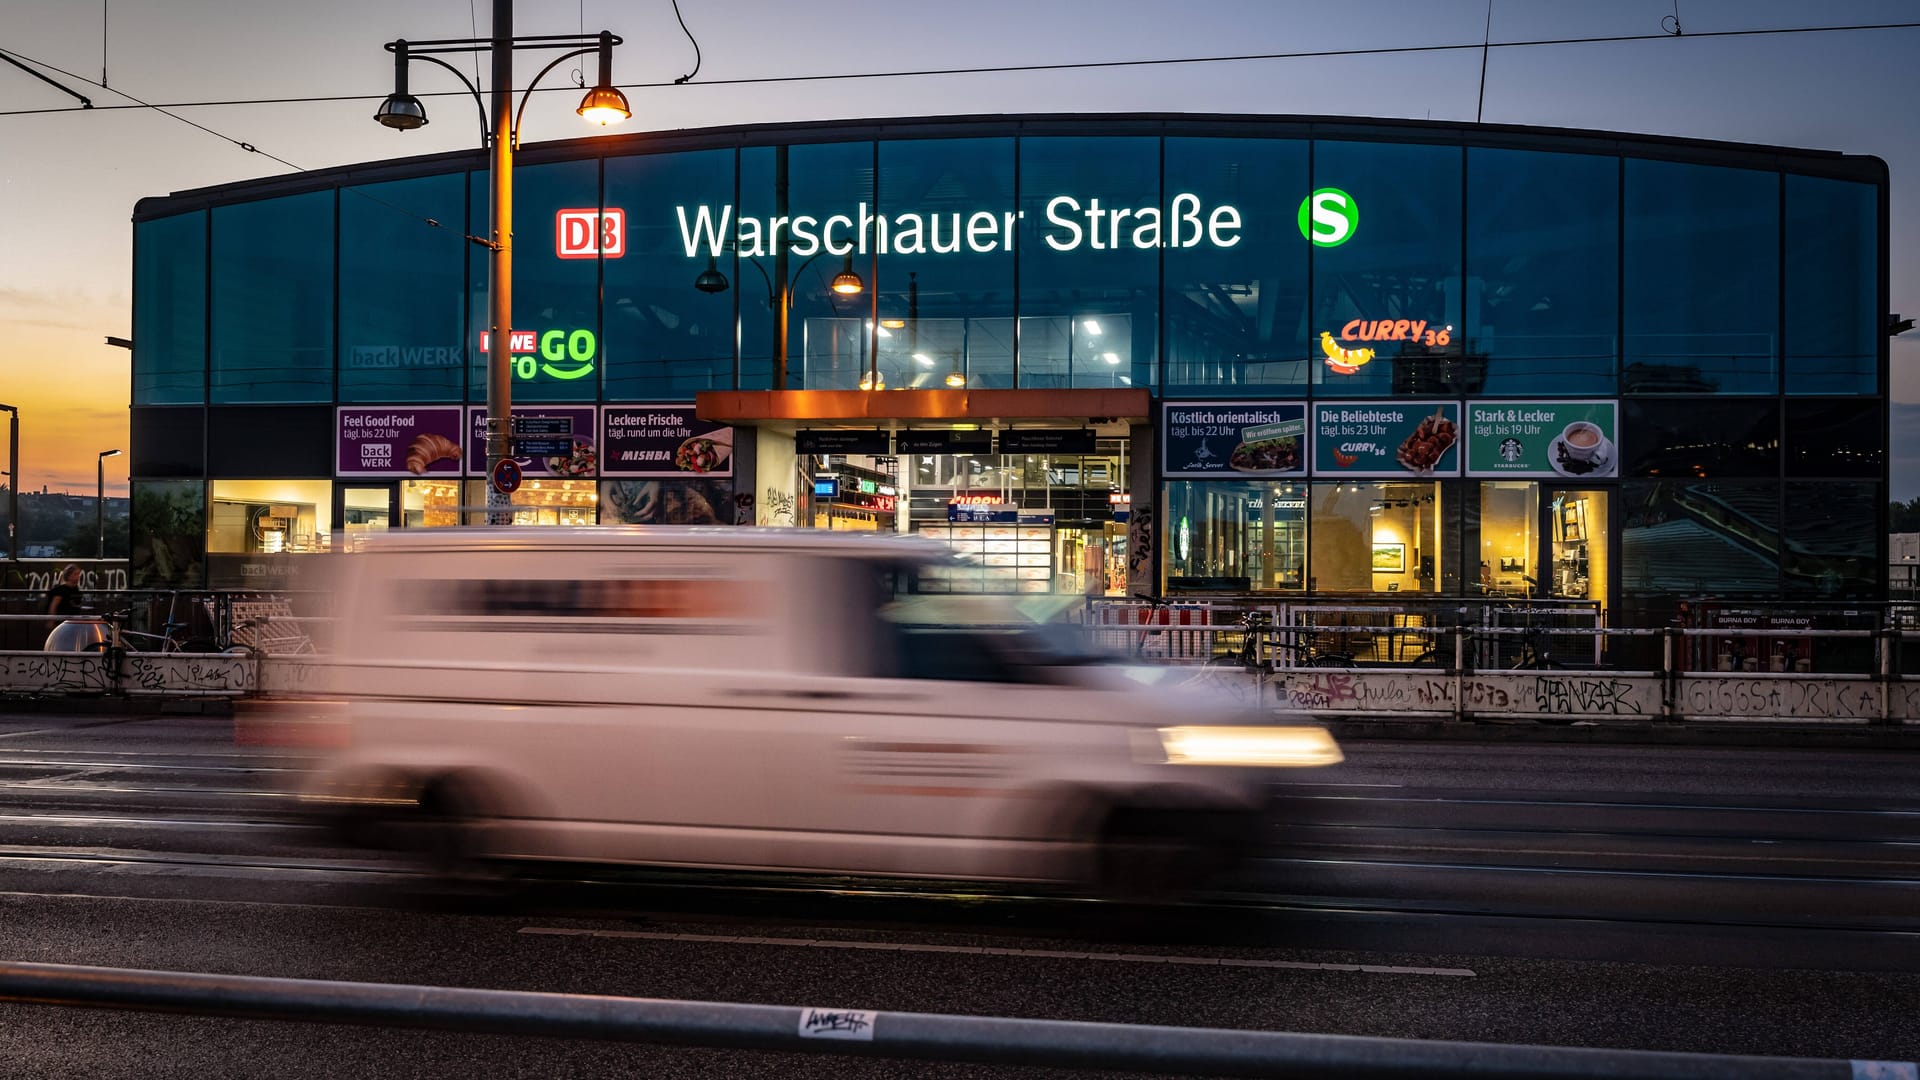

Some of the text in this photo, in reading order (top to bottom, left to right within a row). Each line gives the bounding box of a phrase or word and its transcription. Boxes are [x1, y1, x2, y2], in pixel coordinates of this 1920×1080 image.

[1308, 192, 1350, 243] S
[675, 192, 1242, 258] Warschauer Straße
[563, 215, 618, 252] DB
[1340, 319, 1450, 347] CURRY 36
[541, 329, 596, 361] GO
[343, 415, 415, 427] Feel Good Food
[474, 415, 488, 427] Au
[608, 414, 683, 426] Leckere Frische
[1171, 411, 1281, 424] Köstlich orientalisch
[1320, 410, 1404, 423] Die Beliebteste
[1474, 410, 1556, 422] Stark & Lecker
[344, 428, 400, 440] tägl. bis 22 Uhr
[608, 428, 692, 440] tägl. rund um die Uhr
[1171, 426, 1235, 438] tägl. bis 22 Uhr
[1320, 425, 1387, 438] tägl. bis 23 Uhr
[1474, 425, 1541, 437] tägl. bis 19 Uhr
[362, 444, 391, 457] back
[1340, 442, 1376, 452] CURRY
[621, 450, 671, 461] MISHBA
[361, 458, 392, 468] WERK
